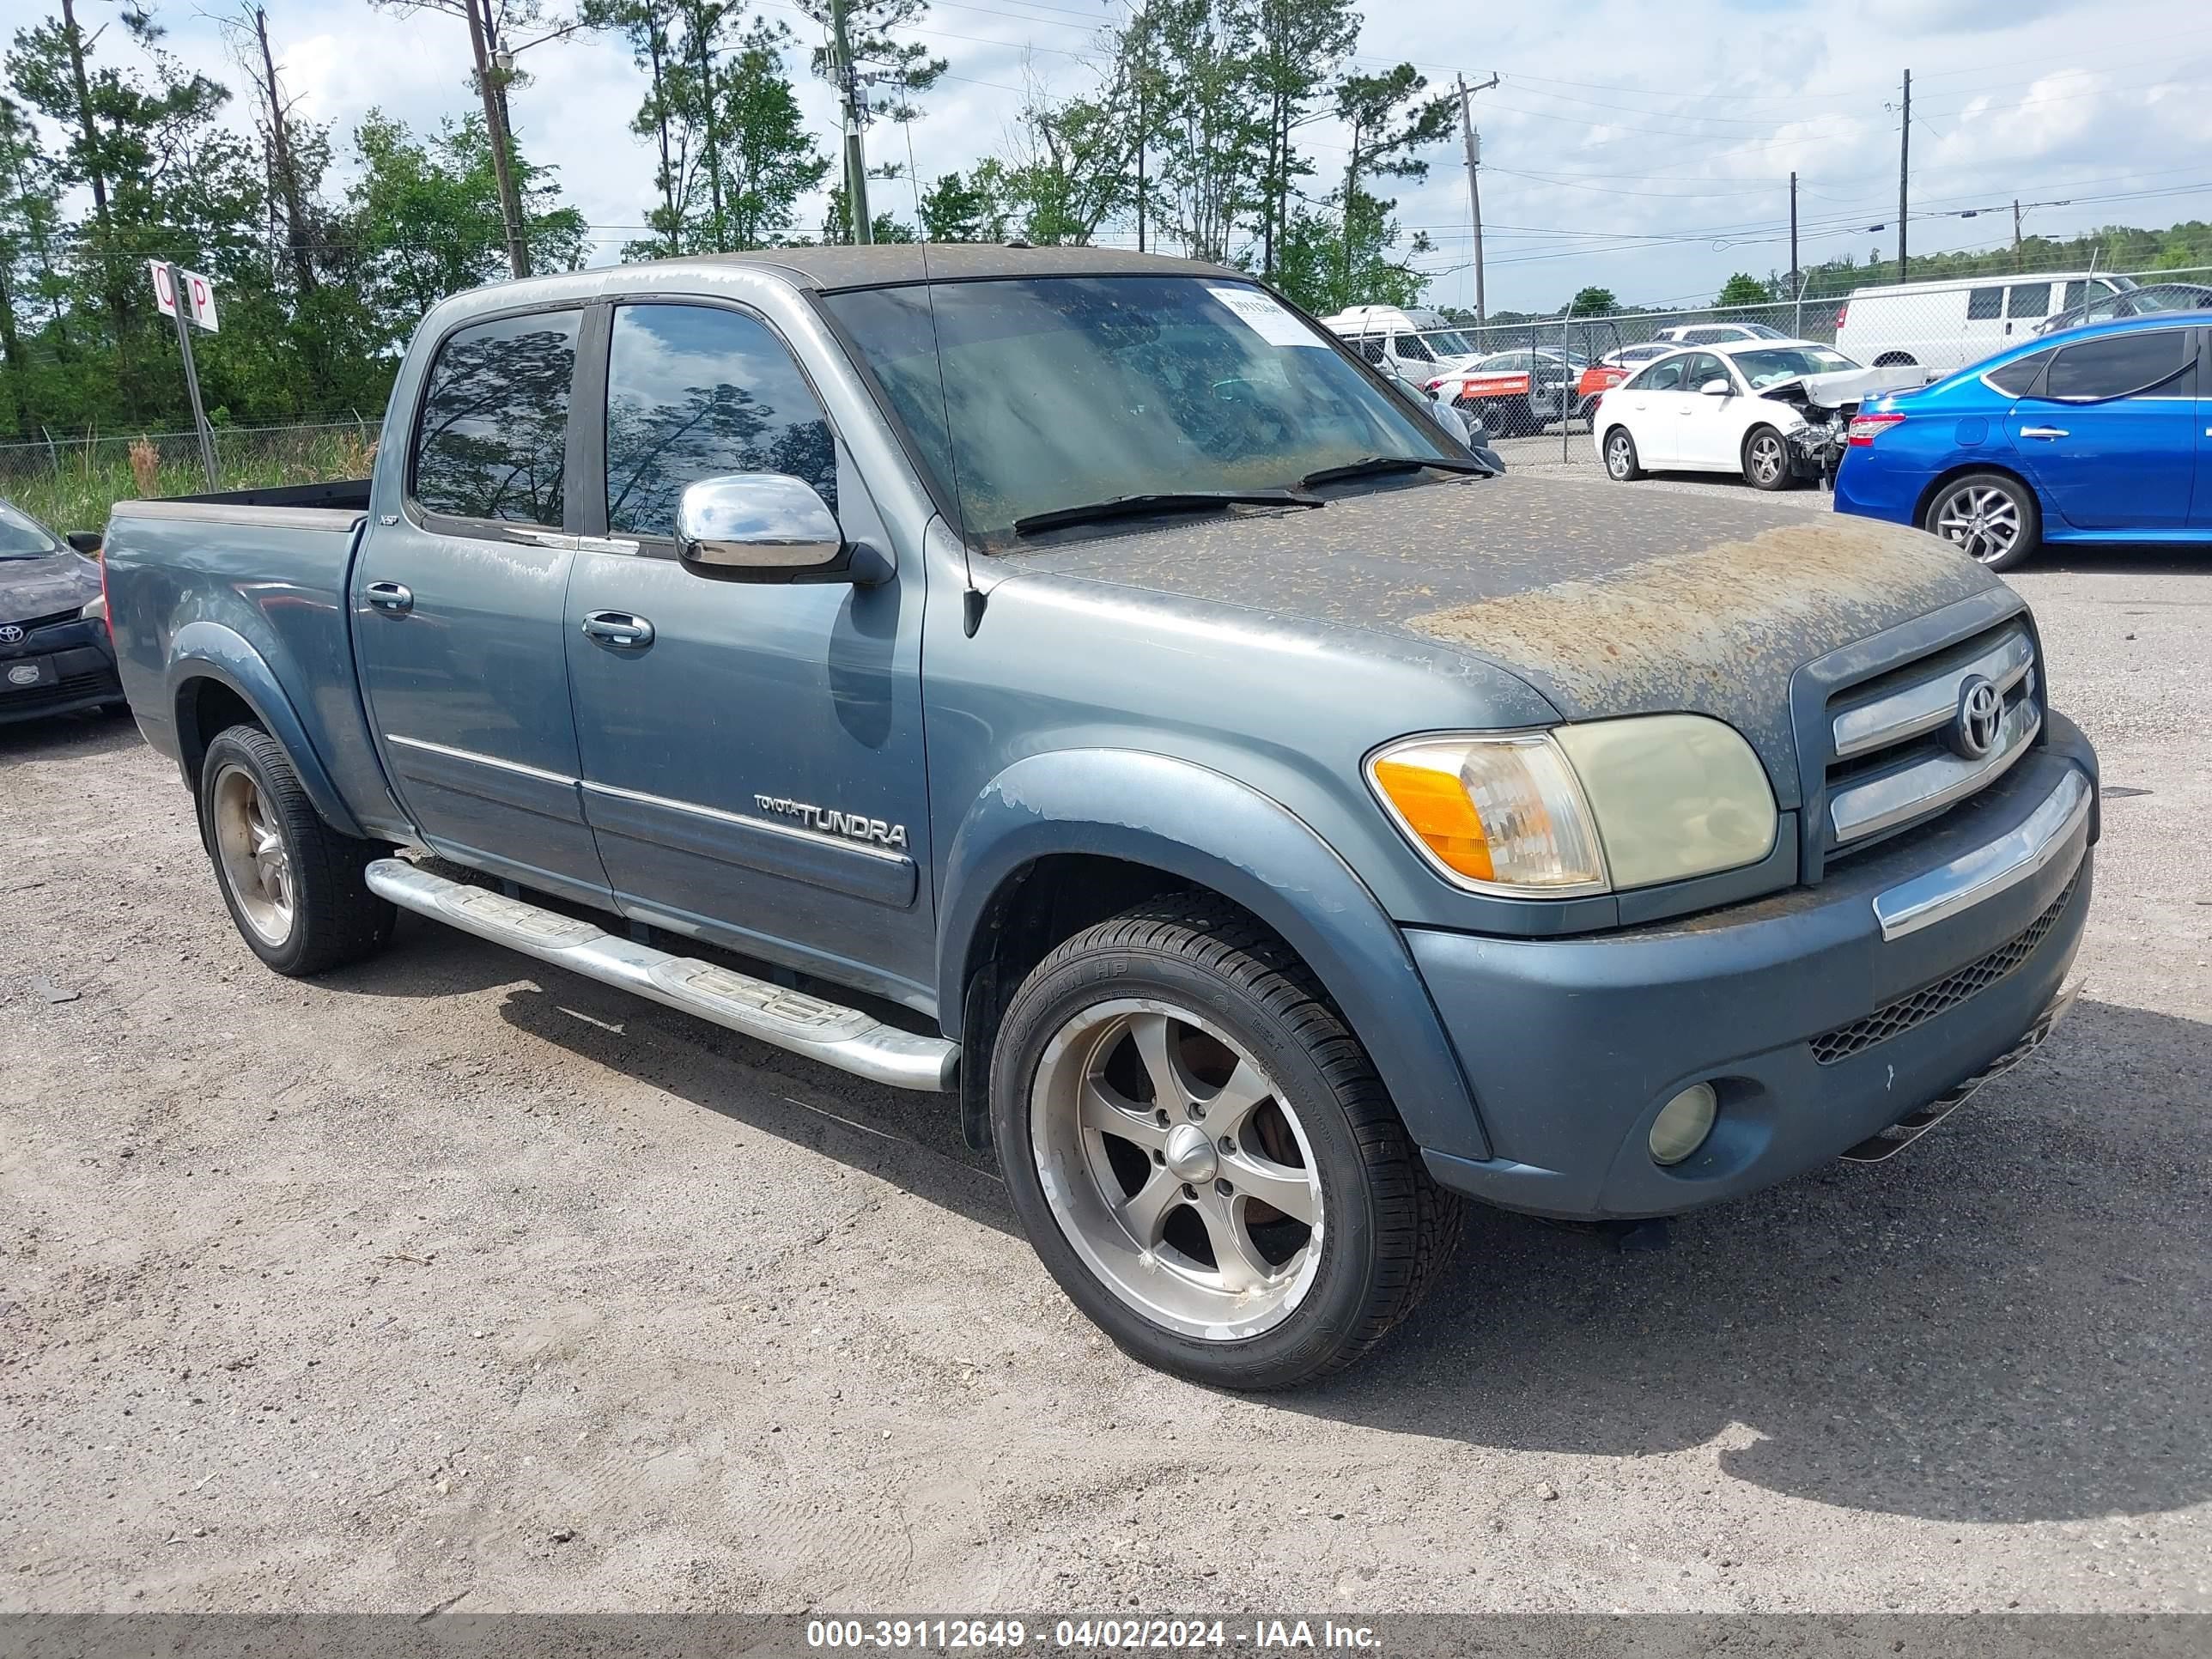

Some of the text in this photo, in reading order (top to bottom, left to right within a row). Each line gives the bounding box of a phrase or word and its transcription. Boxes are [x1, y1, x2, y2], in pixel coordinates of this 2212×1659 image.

[194, 280, 206, 319] P
[797, 804, 908, 848] TUNDRA
[1093, 958, 1129, 981] HP
